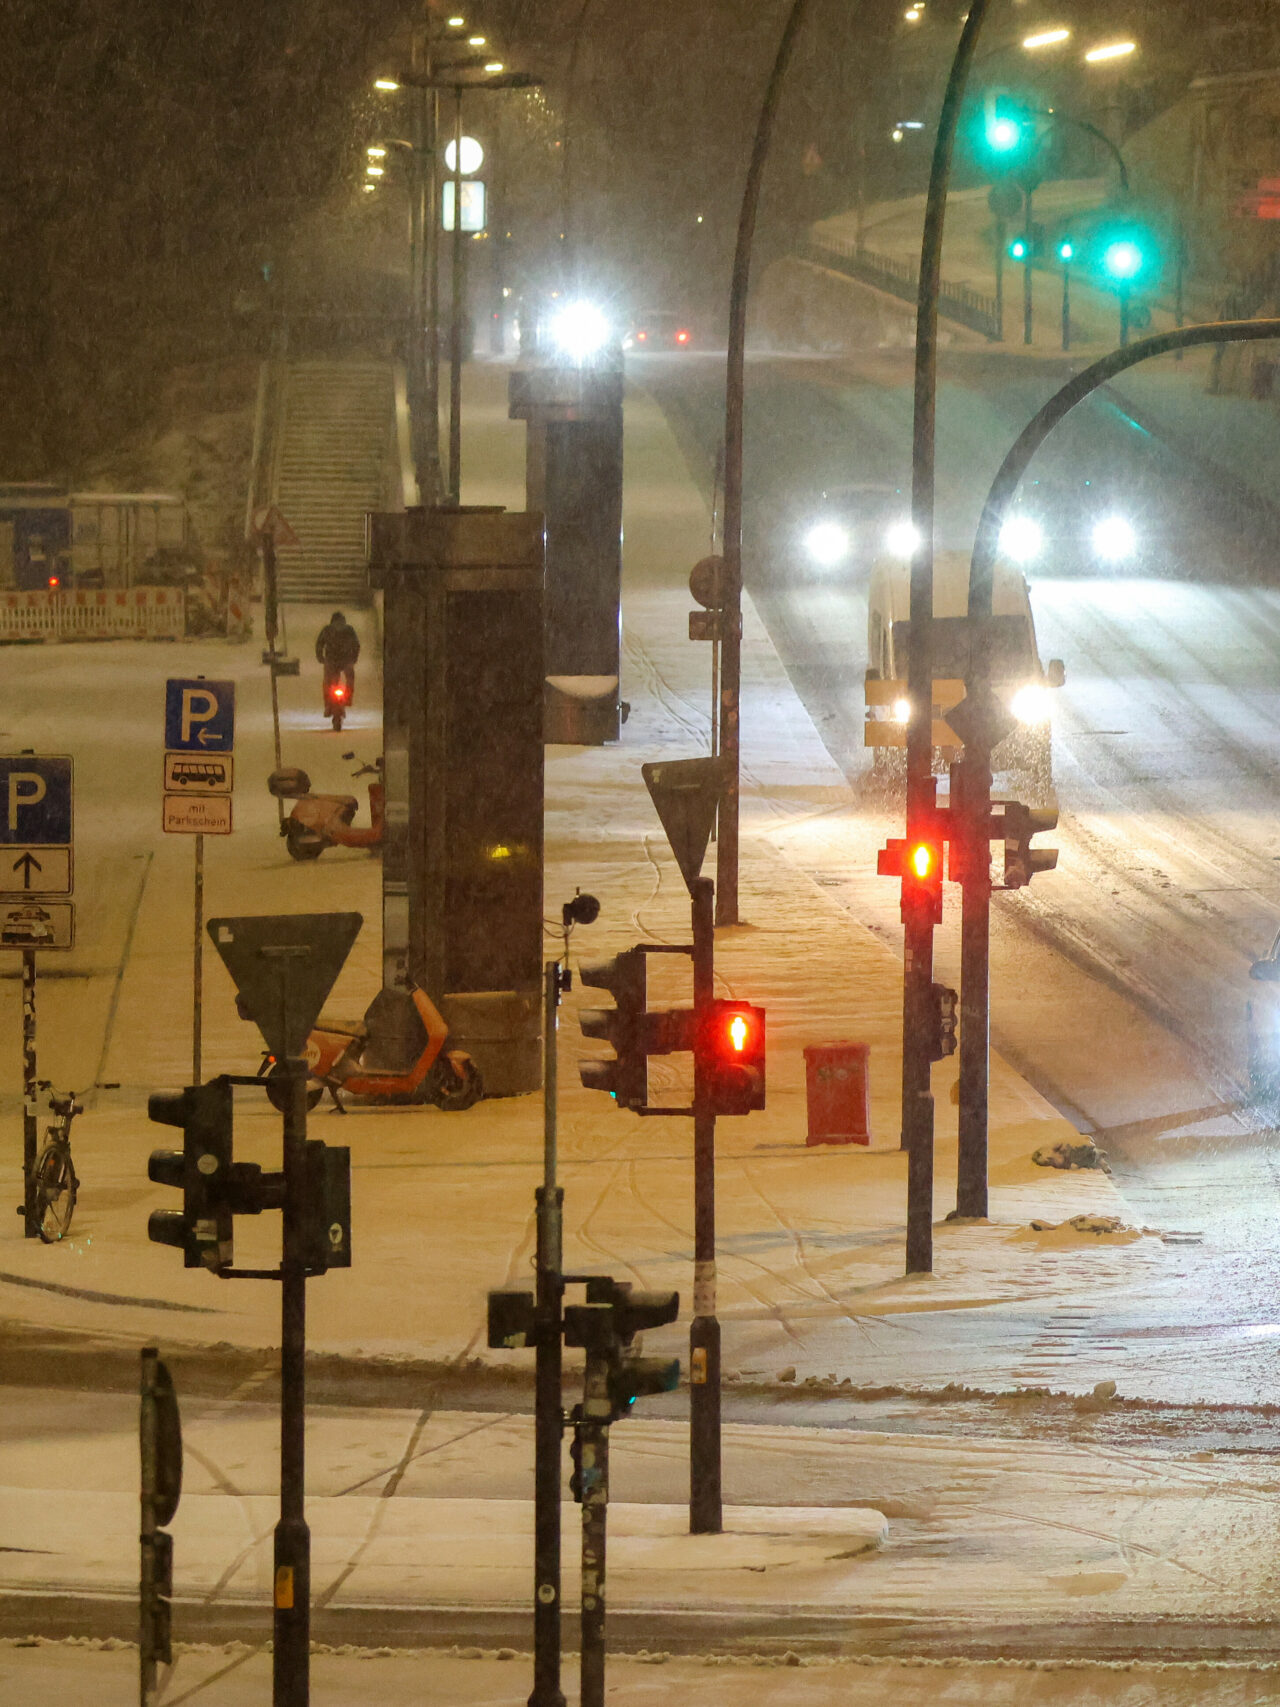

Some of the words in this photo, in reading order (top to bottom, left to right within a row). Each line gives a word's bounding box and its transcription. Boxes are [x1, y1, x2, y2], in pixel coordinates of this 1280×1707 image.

[181, 689, 219, 742] P
[8, 772, 47, 831] P
[188, 805, 206, 814] mit
[168, 815, 226, 826] Parkschein
